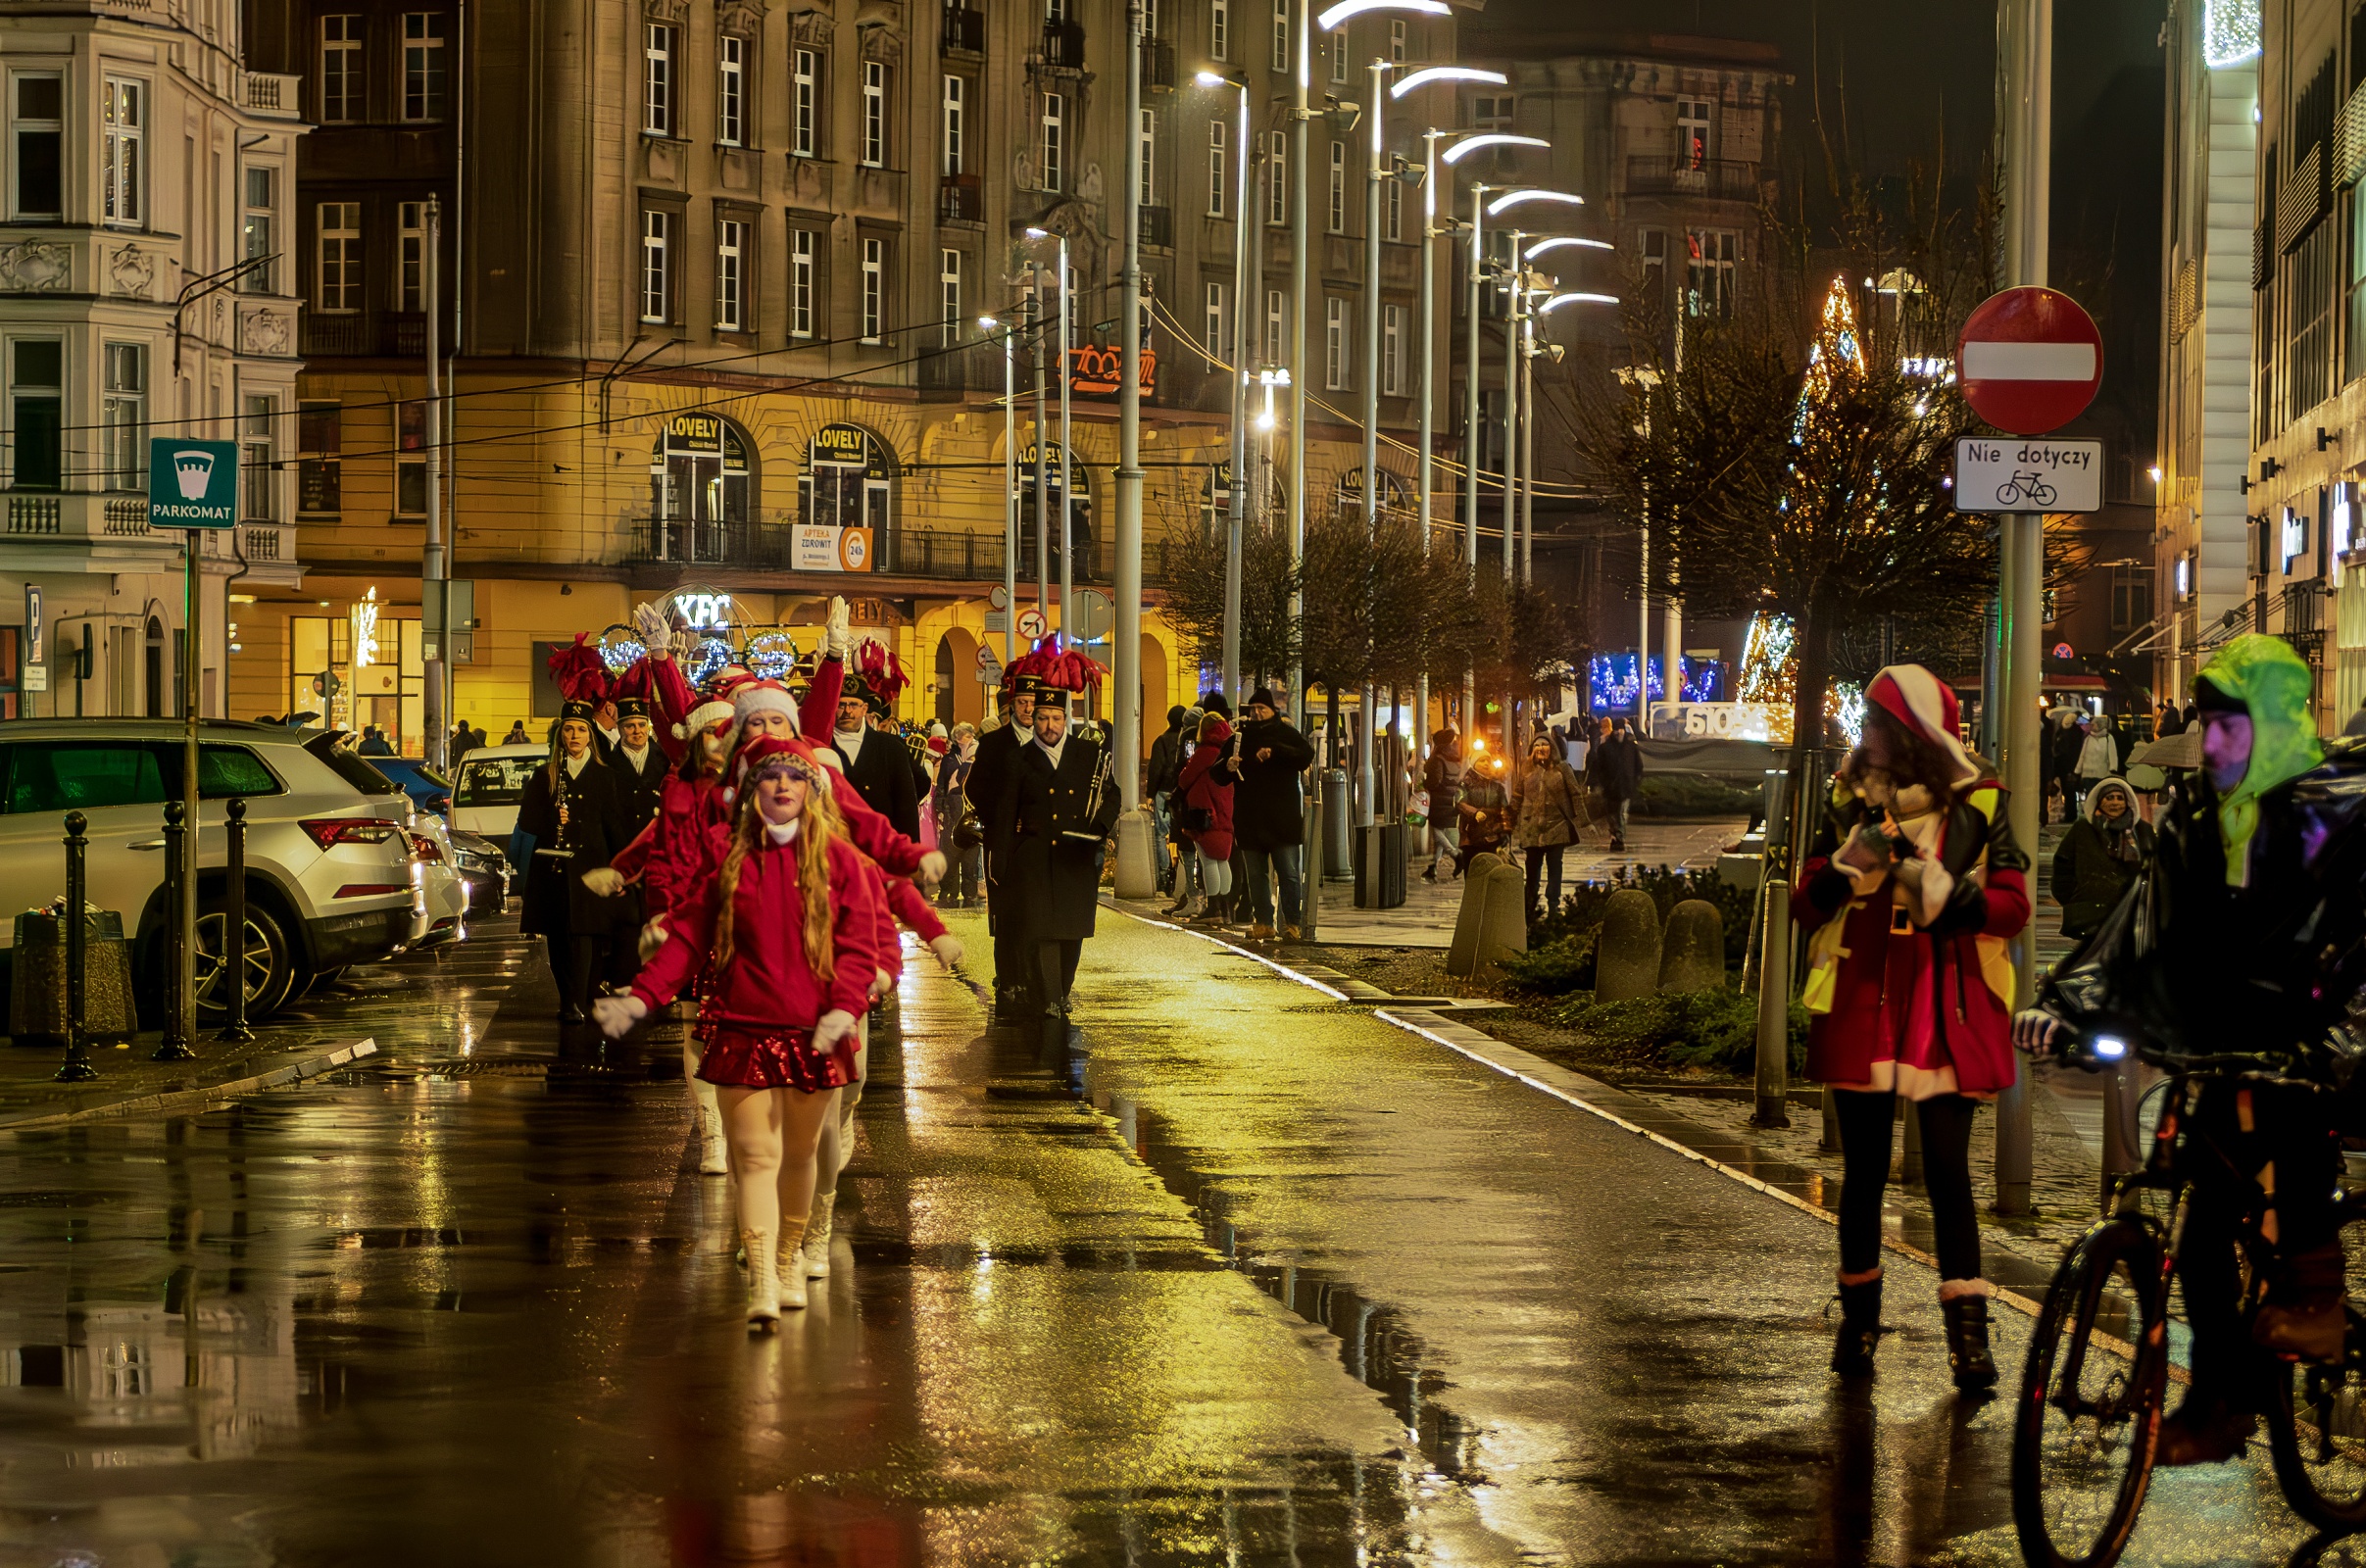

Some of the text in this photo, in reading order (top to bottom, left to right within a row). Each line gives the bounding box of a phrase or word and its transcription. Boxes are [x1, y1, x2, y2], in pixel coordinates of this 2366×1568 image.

[668, 416, 718, 438] LOVELY
[815, 429, 863, 450] LOVELY
[1022, 446, 1062, 464] LOELY
[1968, 443, 2091, 470] Nie dotyczy
[153, 504, 231, 520] PARKOMAT
[804, 528, 830, 538] APTEKA
[802, 539, 831, 549] ZDROWIT
[850, 545, 863, 556] 24h
[30, 593, 39, 640] P
[673, 593, 731, 628] KFC
